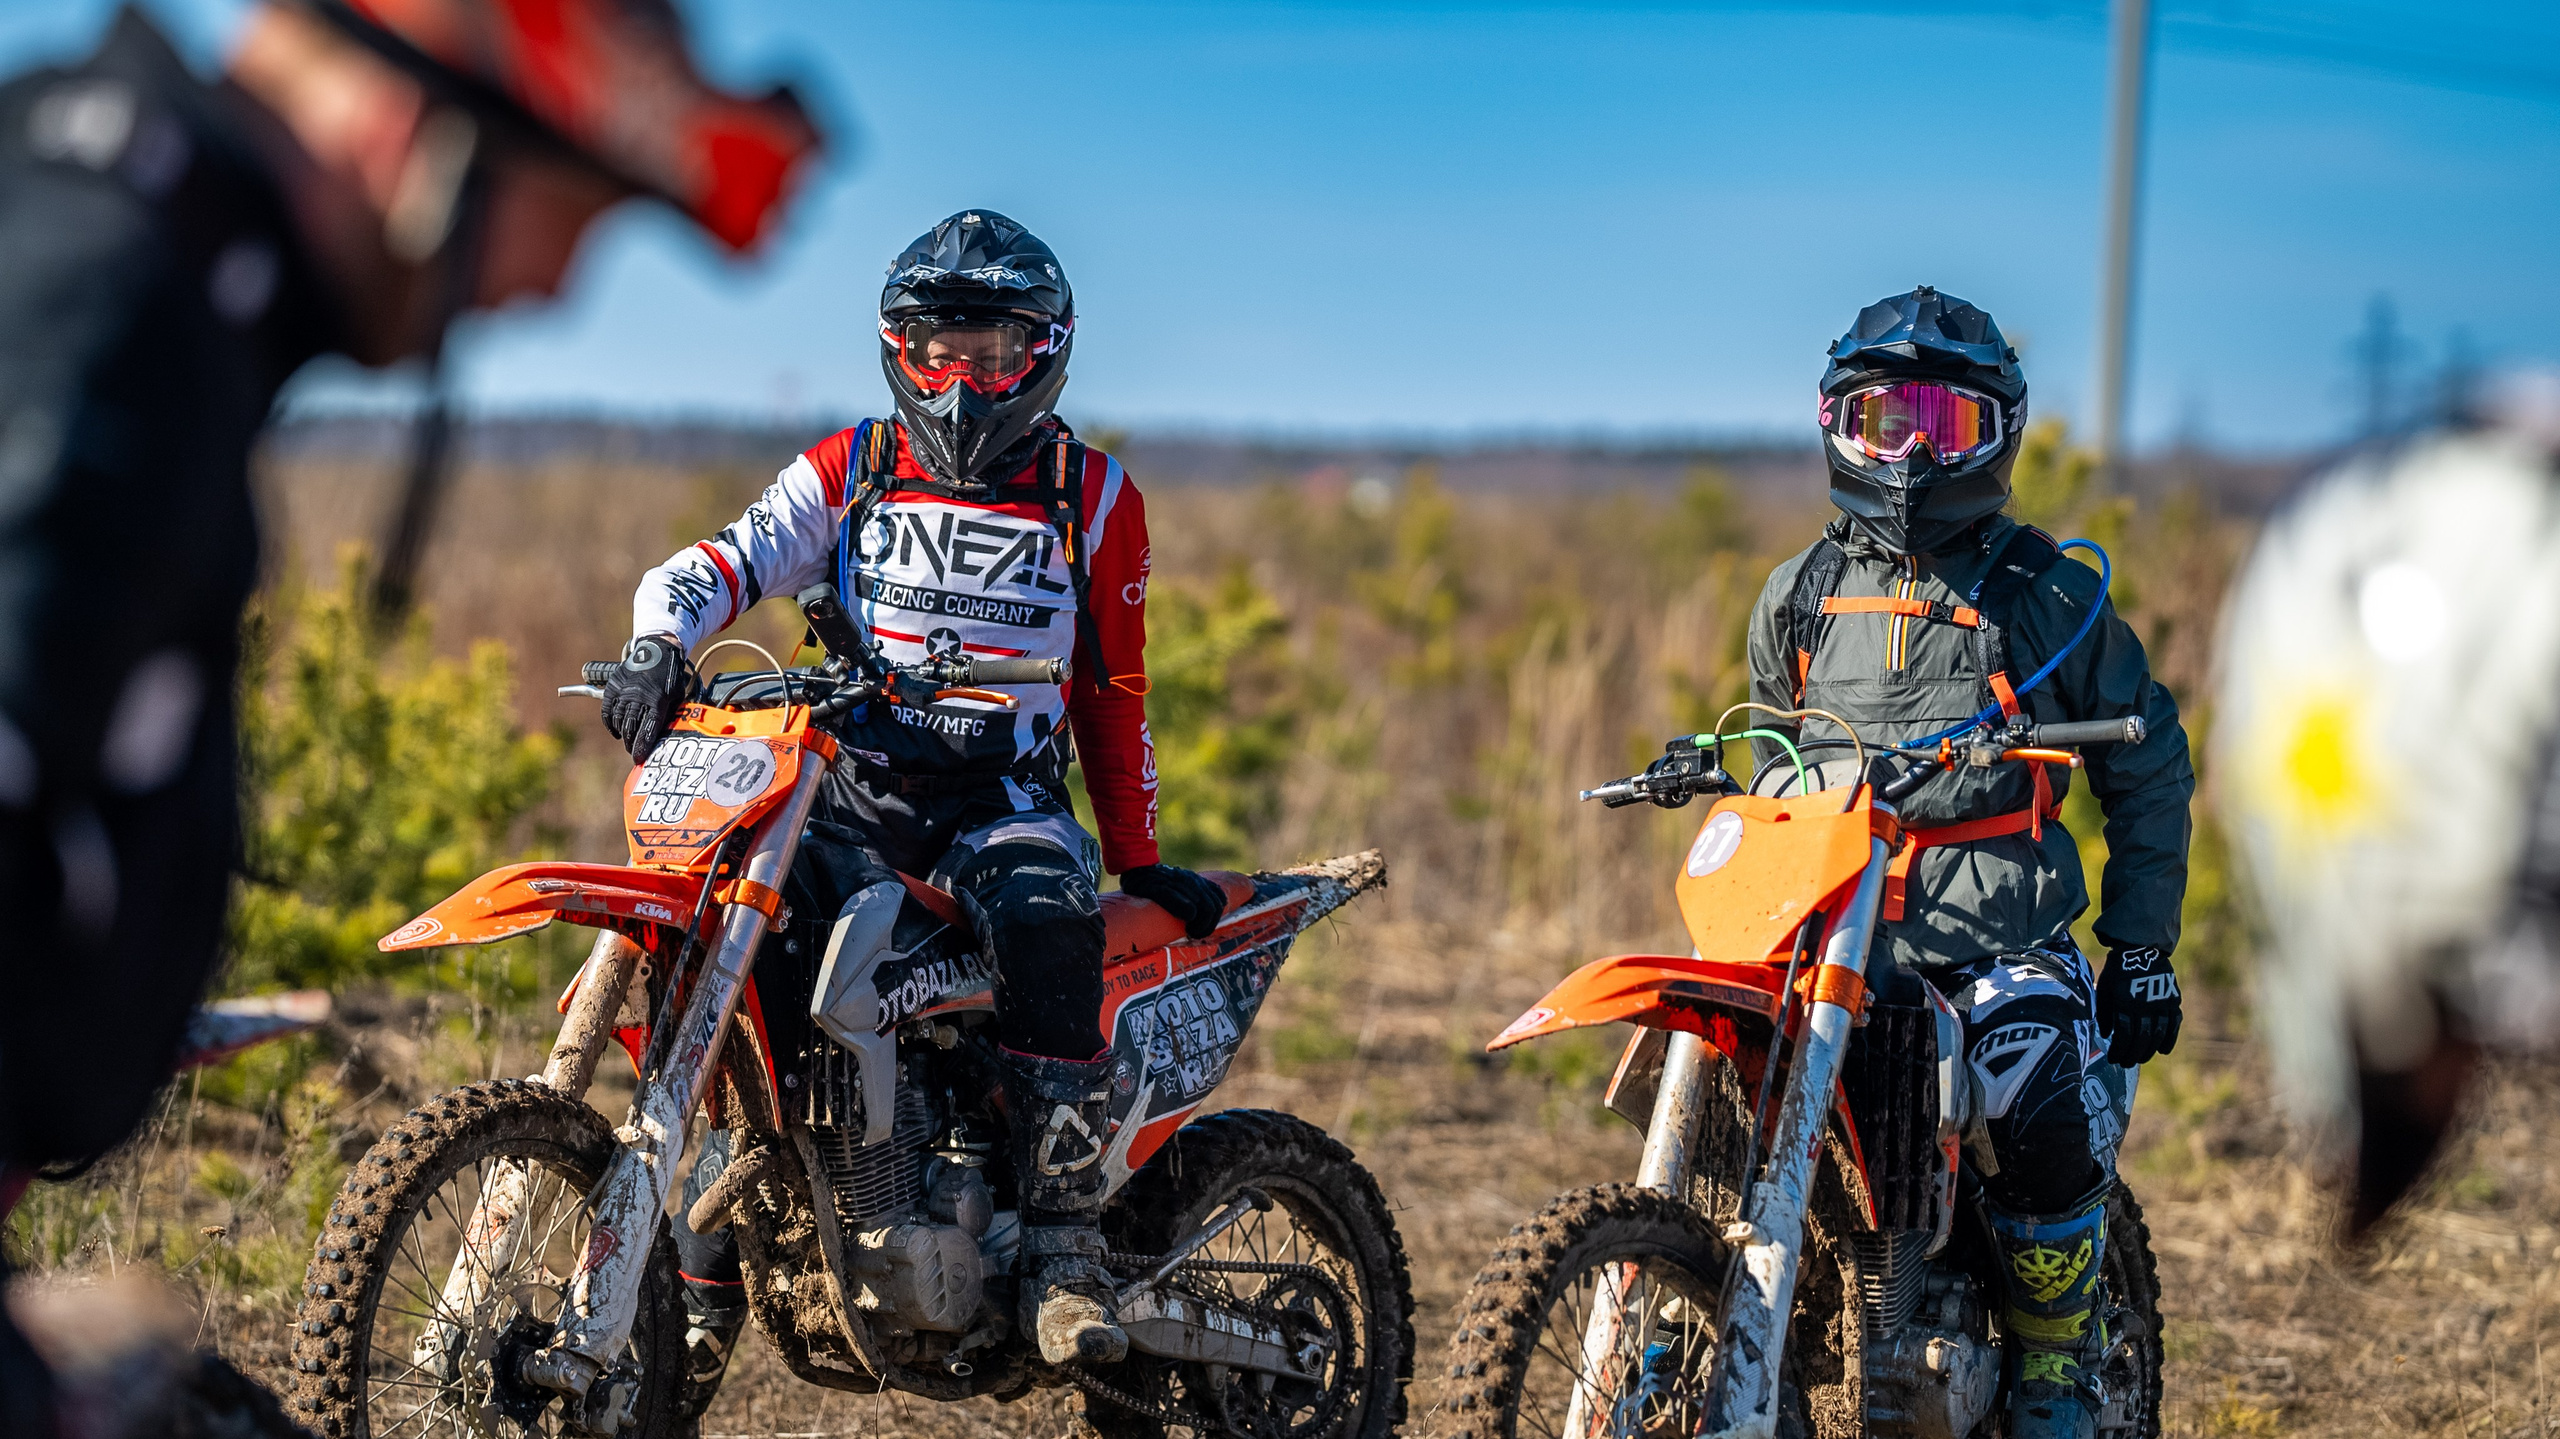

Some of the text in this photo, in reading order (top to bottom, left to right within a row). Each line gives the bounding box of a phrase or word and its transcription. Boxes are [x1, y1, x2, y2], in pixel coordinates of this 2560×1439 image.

[967, 432, 987, 468] Airoh
[871, 580, 1036, 624] RACING COMPANY
[714, 752, 767, 795] 20
[636, 794, 694, 825] RU
[1687, 818, 1742, 872] 27
[634, 901, 672, 921] KTM
[1115, 972, 1131, 989] TO
[1132, 961, 1160, 985] RACE
[2130, 973, 2180, 1003] FOX
[1124, 976, 1228, 1049] MOTO
[1974, 1026, 2053, 1064] thor
